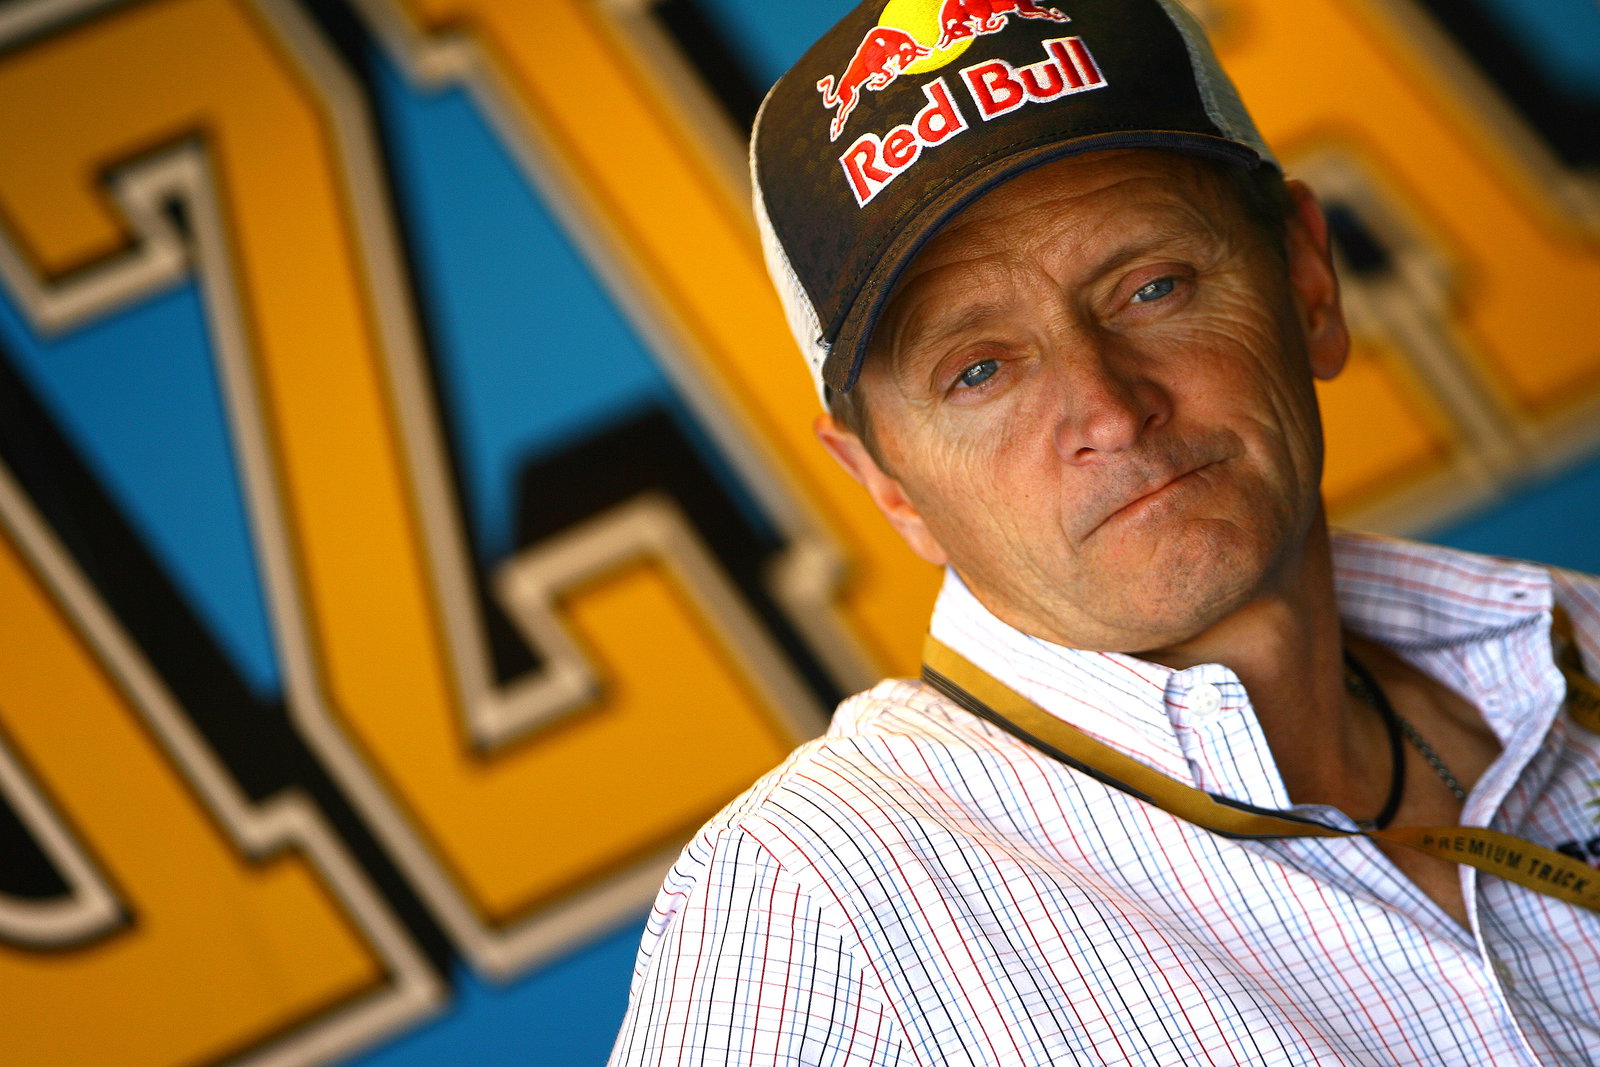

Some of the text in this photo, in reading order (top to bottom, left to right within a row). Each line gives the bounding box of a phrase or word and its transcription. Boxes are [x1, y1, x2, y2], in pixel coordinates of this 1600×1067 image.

[839, 36, 1108, 207] Red Bull
[1422, 834, 1523, 869] PREMIUM
